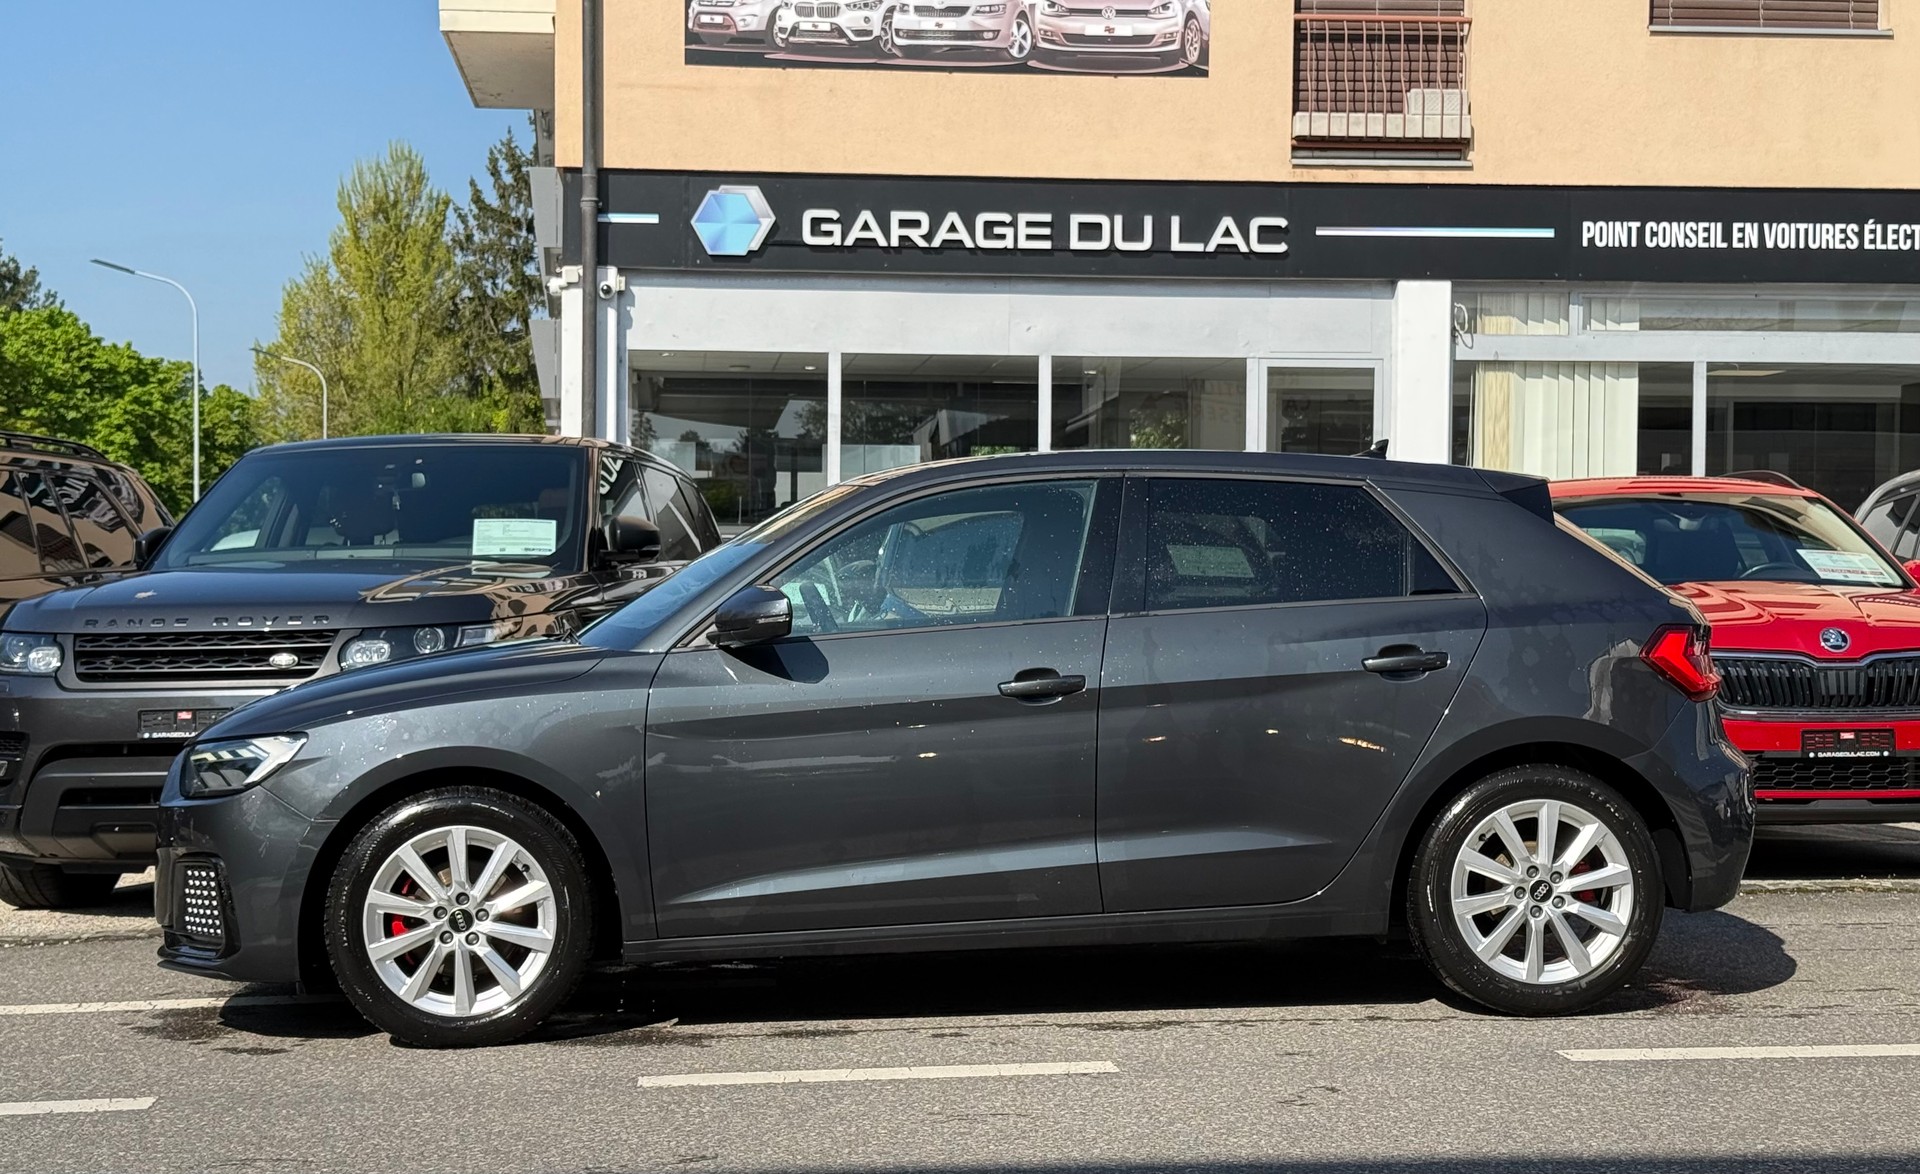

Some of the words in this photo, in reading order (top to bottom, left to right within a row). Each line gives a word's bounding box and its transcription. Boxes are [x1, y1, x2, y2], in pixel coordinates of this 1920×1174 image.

[801, 208, 1053, 251] GARAGE
[1069, 213, 1153, 252] DU
[1171, 215, 1289, 254] LAC
[1582, 220, 1641, 248] POINT
[1645, 221, 1728, 249] CONSEIL
[1732, 222, 1758, 249] EN
[1763, 222, 1859, 250] VOITURES
[83, 618, 189, 629] RANGE
[212, 614, 330, 627] ROVER
